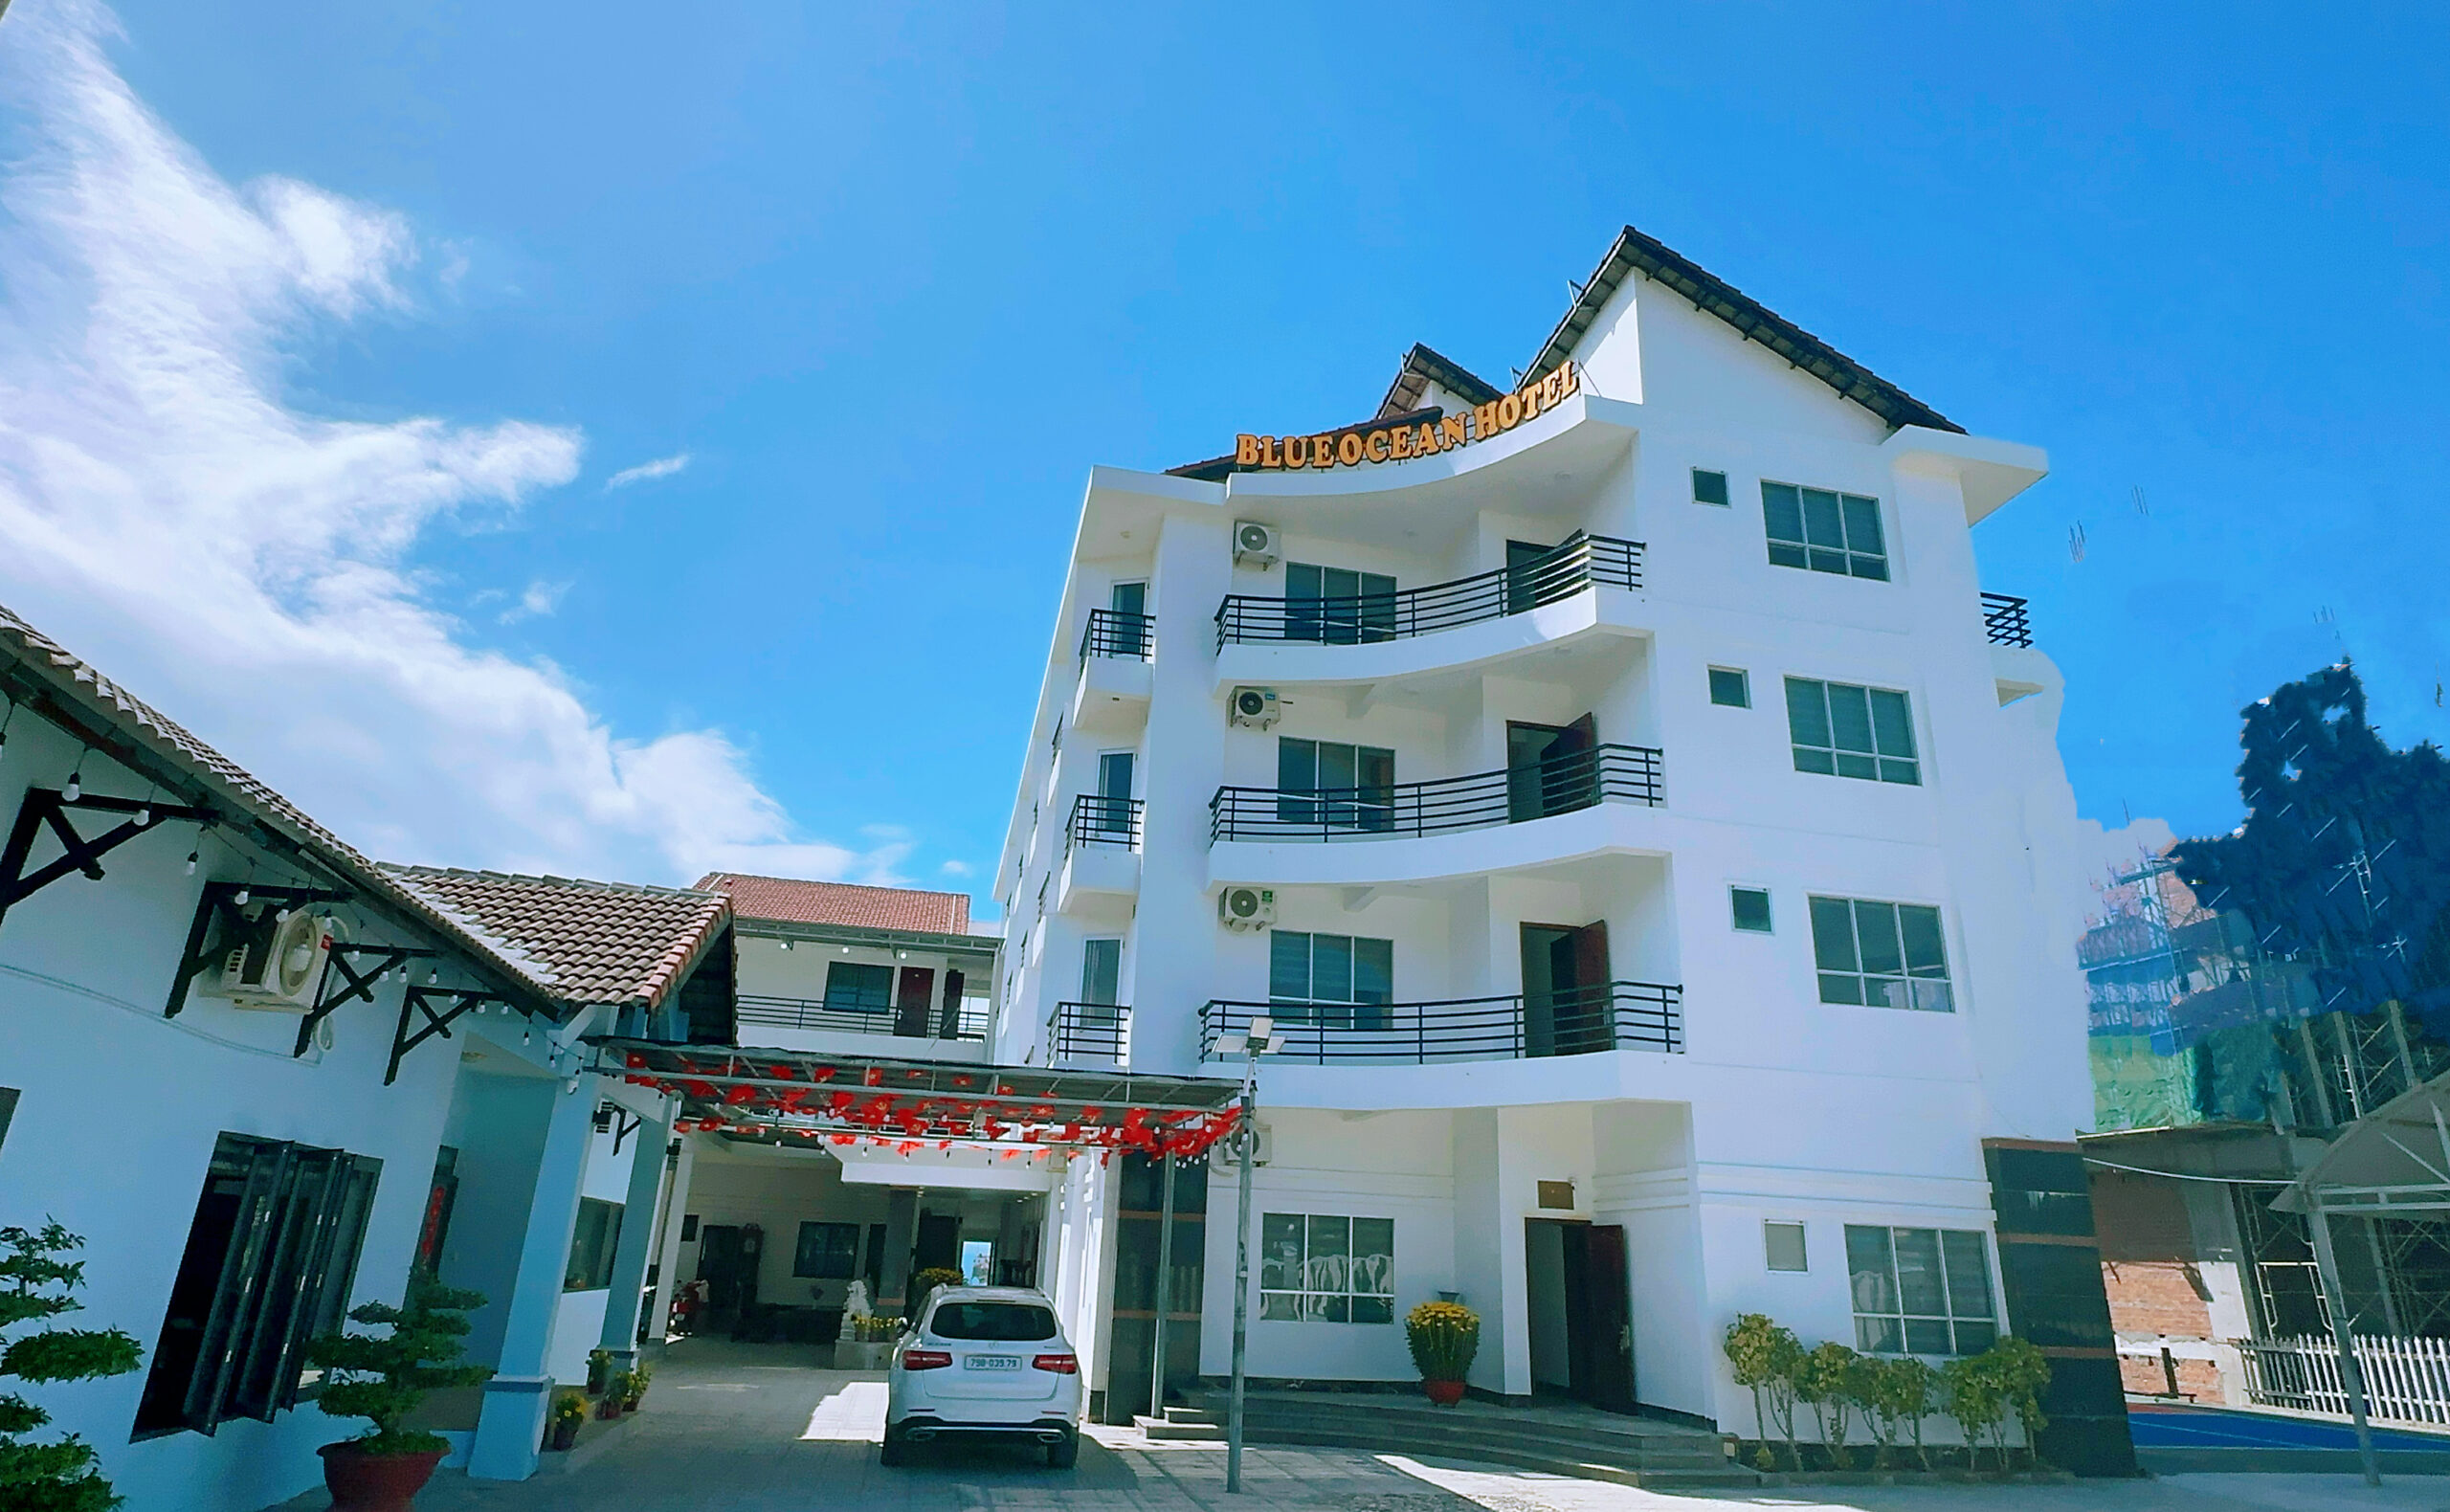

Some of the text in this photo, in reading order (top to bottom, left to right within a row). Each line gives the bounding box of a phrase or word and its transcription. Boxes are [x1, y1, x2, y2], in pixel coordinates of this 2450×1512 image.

[1236, 360, 1579, 468] BLUE OCEAN HOTEL
